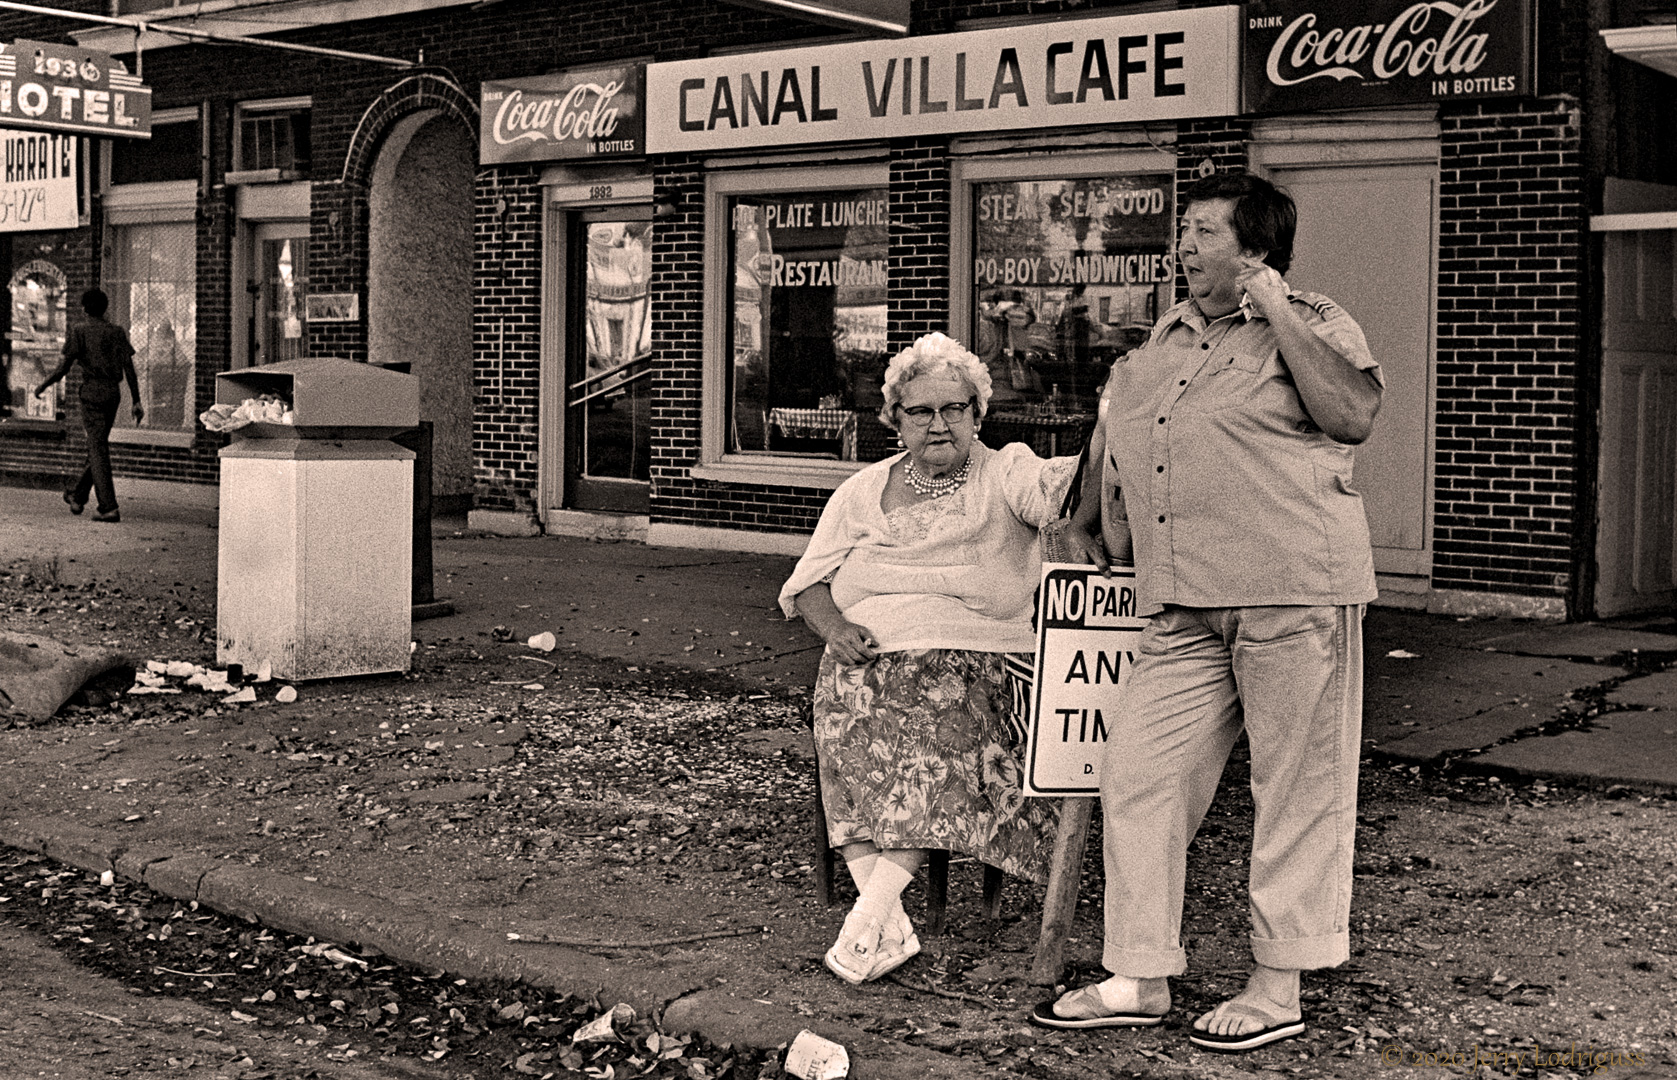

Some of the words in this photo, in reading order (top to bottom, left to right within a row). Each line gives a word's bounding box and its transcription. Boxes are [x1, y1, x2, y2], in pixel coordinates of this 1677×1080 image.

[1249, 16, 1283, 29] DRINK
[1266, 0, 1498, 86] Coca-Cola
[679, 65, 838, 132] CANAL
[862, 47, 1029, 118] VILLA
[1045, 31, 1186, 105] CAFE
[1432, 80, 1448, 95] IN
[1454, 75, 1515, 93] BOTTLES
[493, 80, 625, 144] Coca-Cola
[6, 134, 71, 182] KARATE
[587, 141, 596, 153] IN
[599, 140, 635, 152] BOTTLES
[766, 203, 814, 229] PLATE
[974, 256, 1041, 285] PO-BOY
[1050, 254, 1173, 284] SANDWICHES
[1046, 578, 1085, 621] NO
